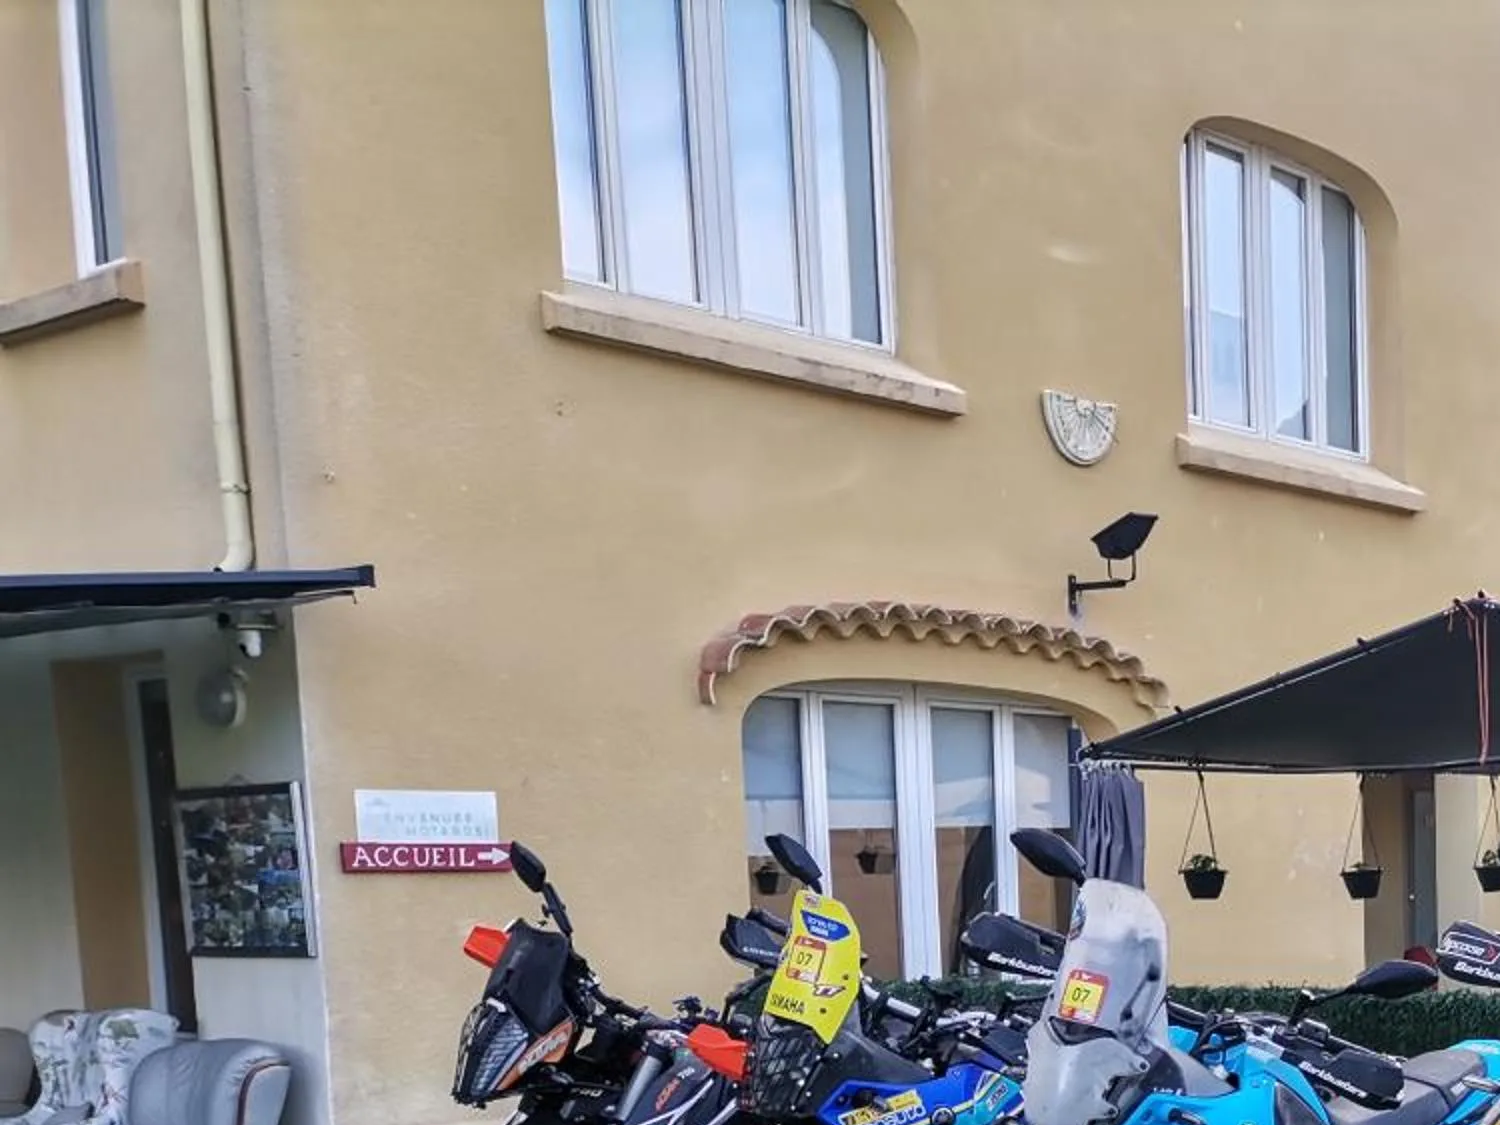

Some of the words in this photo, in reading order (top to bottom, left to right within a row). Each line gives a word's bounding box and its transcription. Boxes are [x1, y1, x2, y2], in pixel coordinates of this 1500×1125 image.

[352, 846, 475, 868] ACCUEIL
[796, 951, 813, 966] 07
[1071, 987, 1091, 1003] 07
